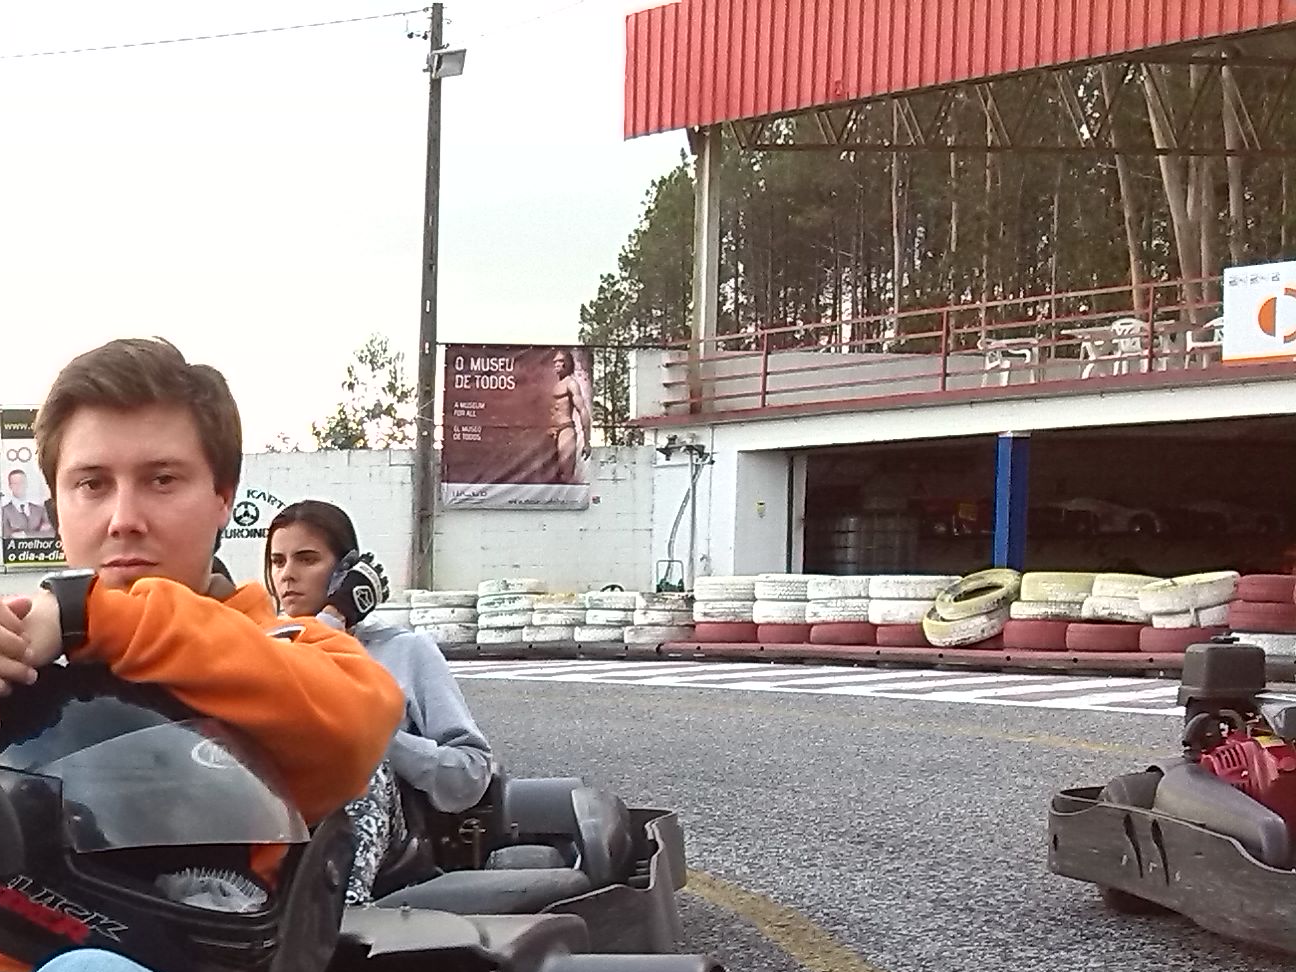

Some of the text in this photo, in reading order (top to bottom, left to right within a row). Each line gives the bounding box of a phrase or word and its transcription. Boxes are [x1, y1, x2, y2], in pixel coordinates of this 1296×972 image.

[455, 356, 514, 372] O MUSEU
[455, 375, 516, 390] DE TODOS
[246, 489, 286, 509] KART
[7, 539, 16, 550] A
[18, 539, 53, 550] melhor
[8, 553, 16, 562] o
